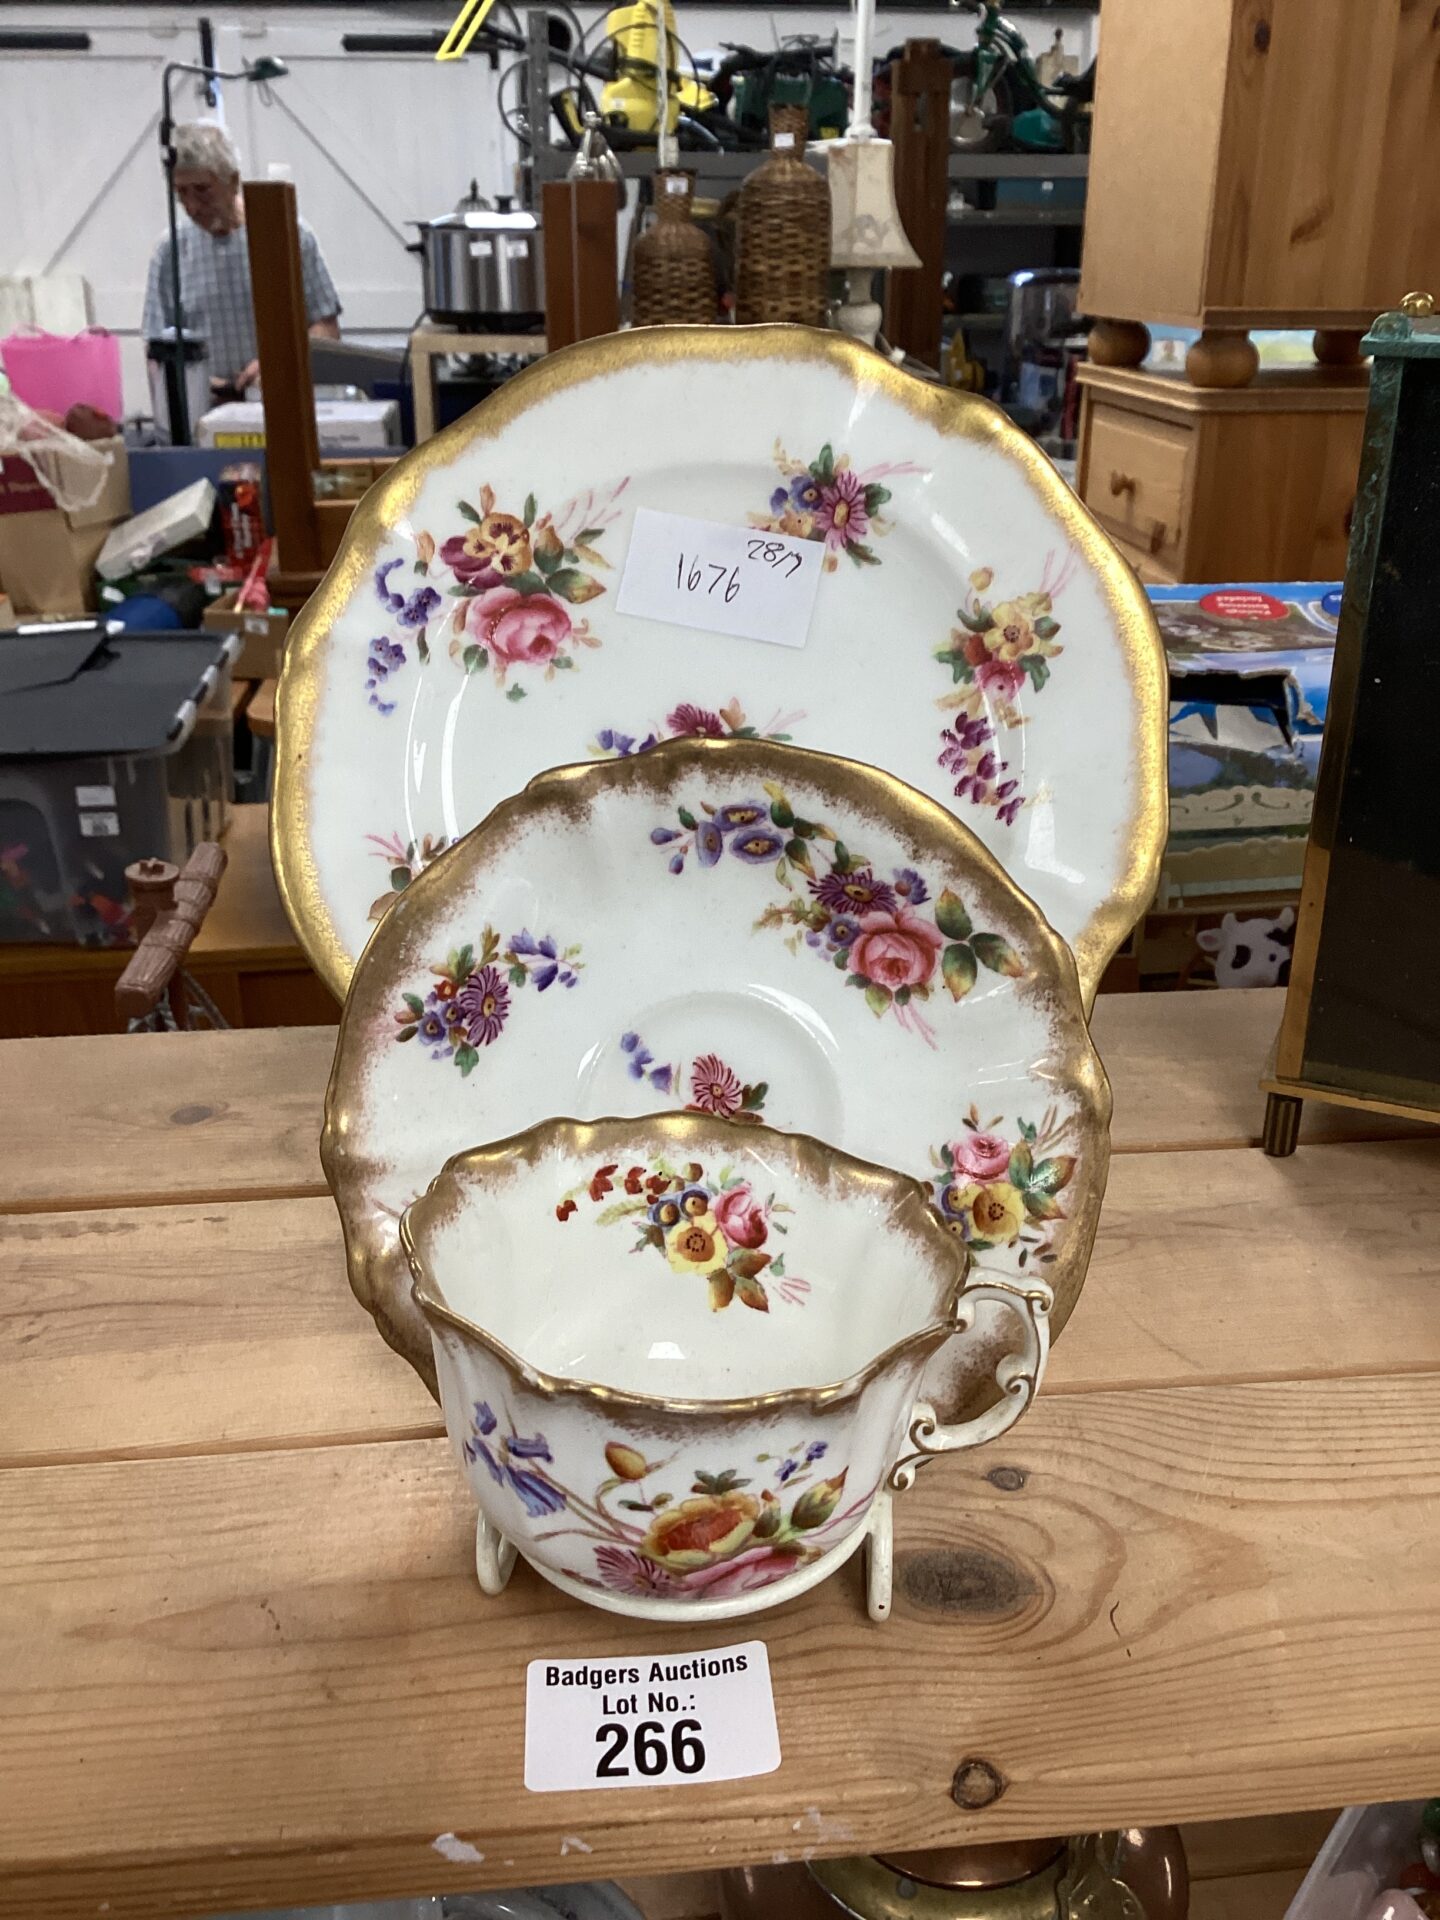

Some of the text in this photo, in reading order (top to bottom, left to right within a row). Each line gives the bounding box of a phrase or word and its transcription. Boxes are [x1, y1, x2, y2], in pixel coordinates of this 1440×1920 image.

[677, 552, 741, 603] 1676
[545, 1654, 748, 1690] Badgers Auctions
[602, 1691, 696, 1715] Lot No.:
[595, 1718, 706, 1778] 266
